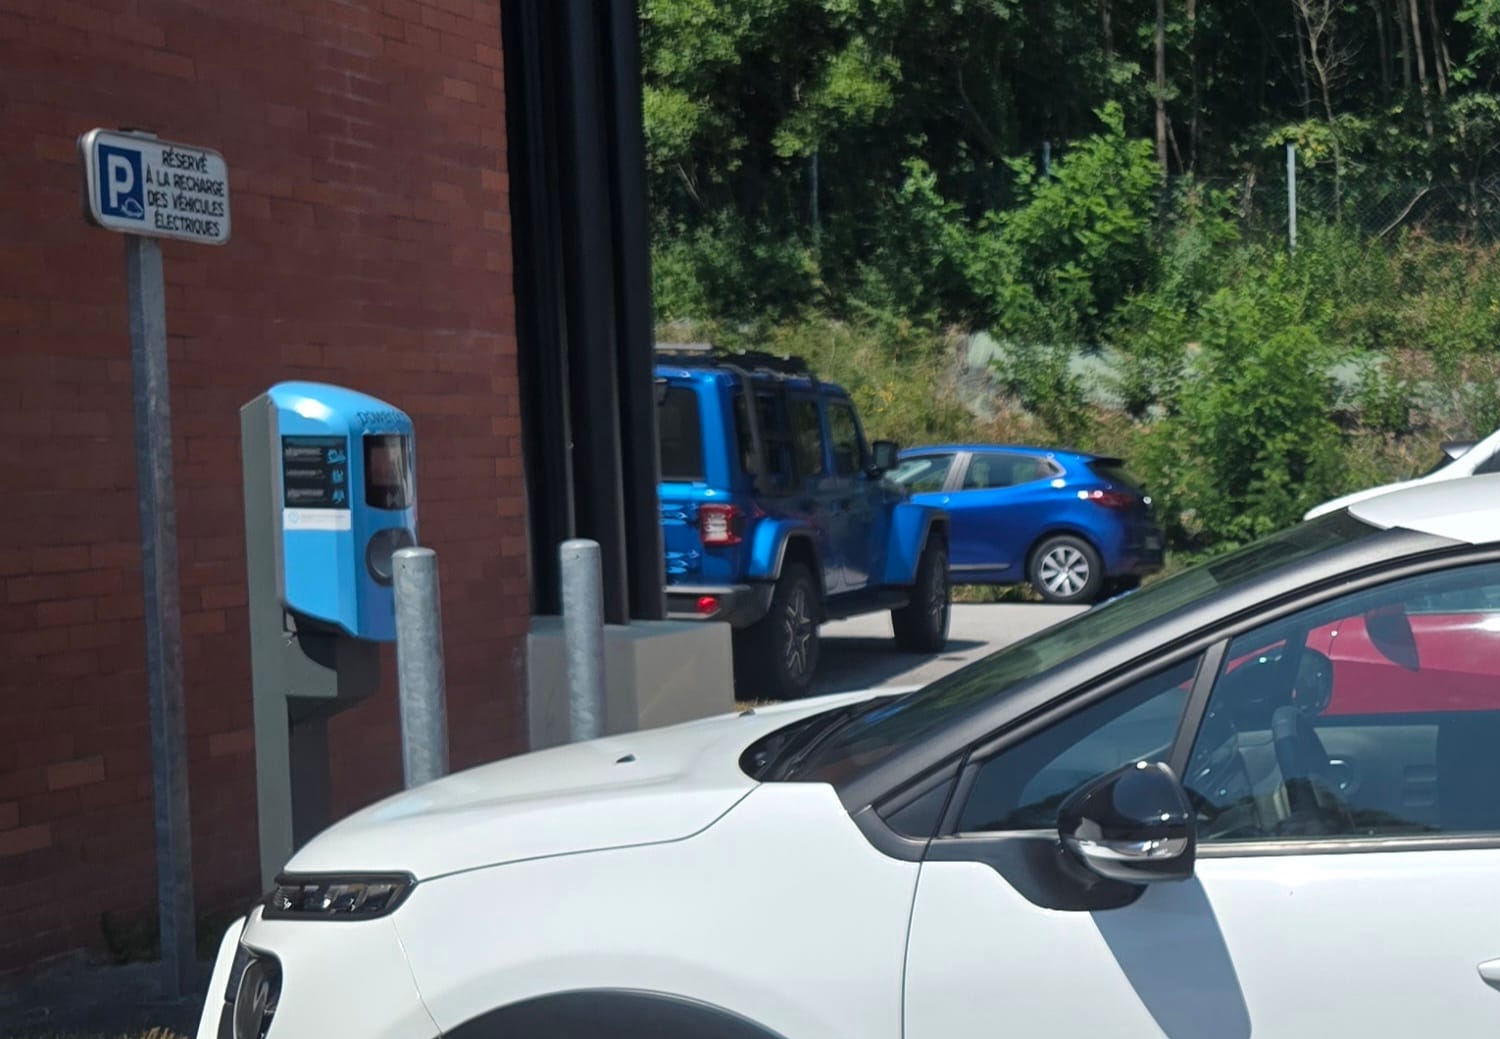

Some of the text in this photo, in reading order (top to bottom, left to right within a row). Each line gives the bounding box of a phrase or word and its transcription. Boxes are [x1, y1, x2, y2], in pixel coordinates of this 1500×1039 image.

[162, 148, 208, 173] RÉSERVÉ
[108, 154, 134, 208] P
[156, 170, 170, 187] LA
[174, 174, 224, 197] RECHARGE
[147, 190, 224, 217] DES VÉHICULES
[154, 209, 220, 237] ÉLECTRIQUES
